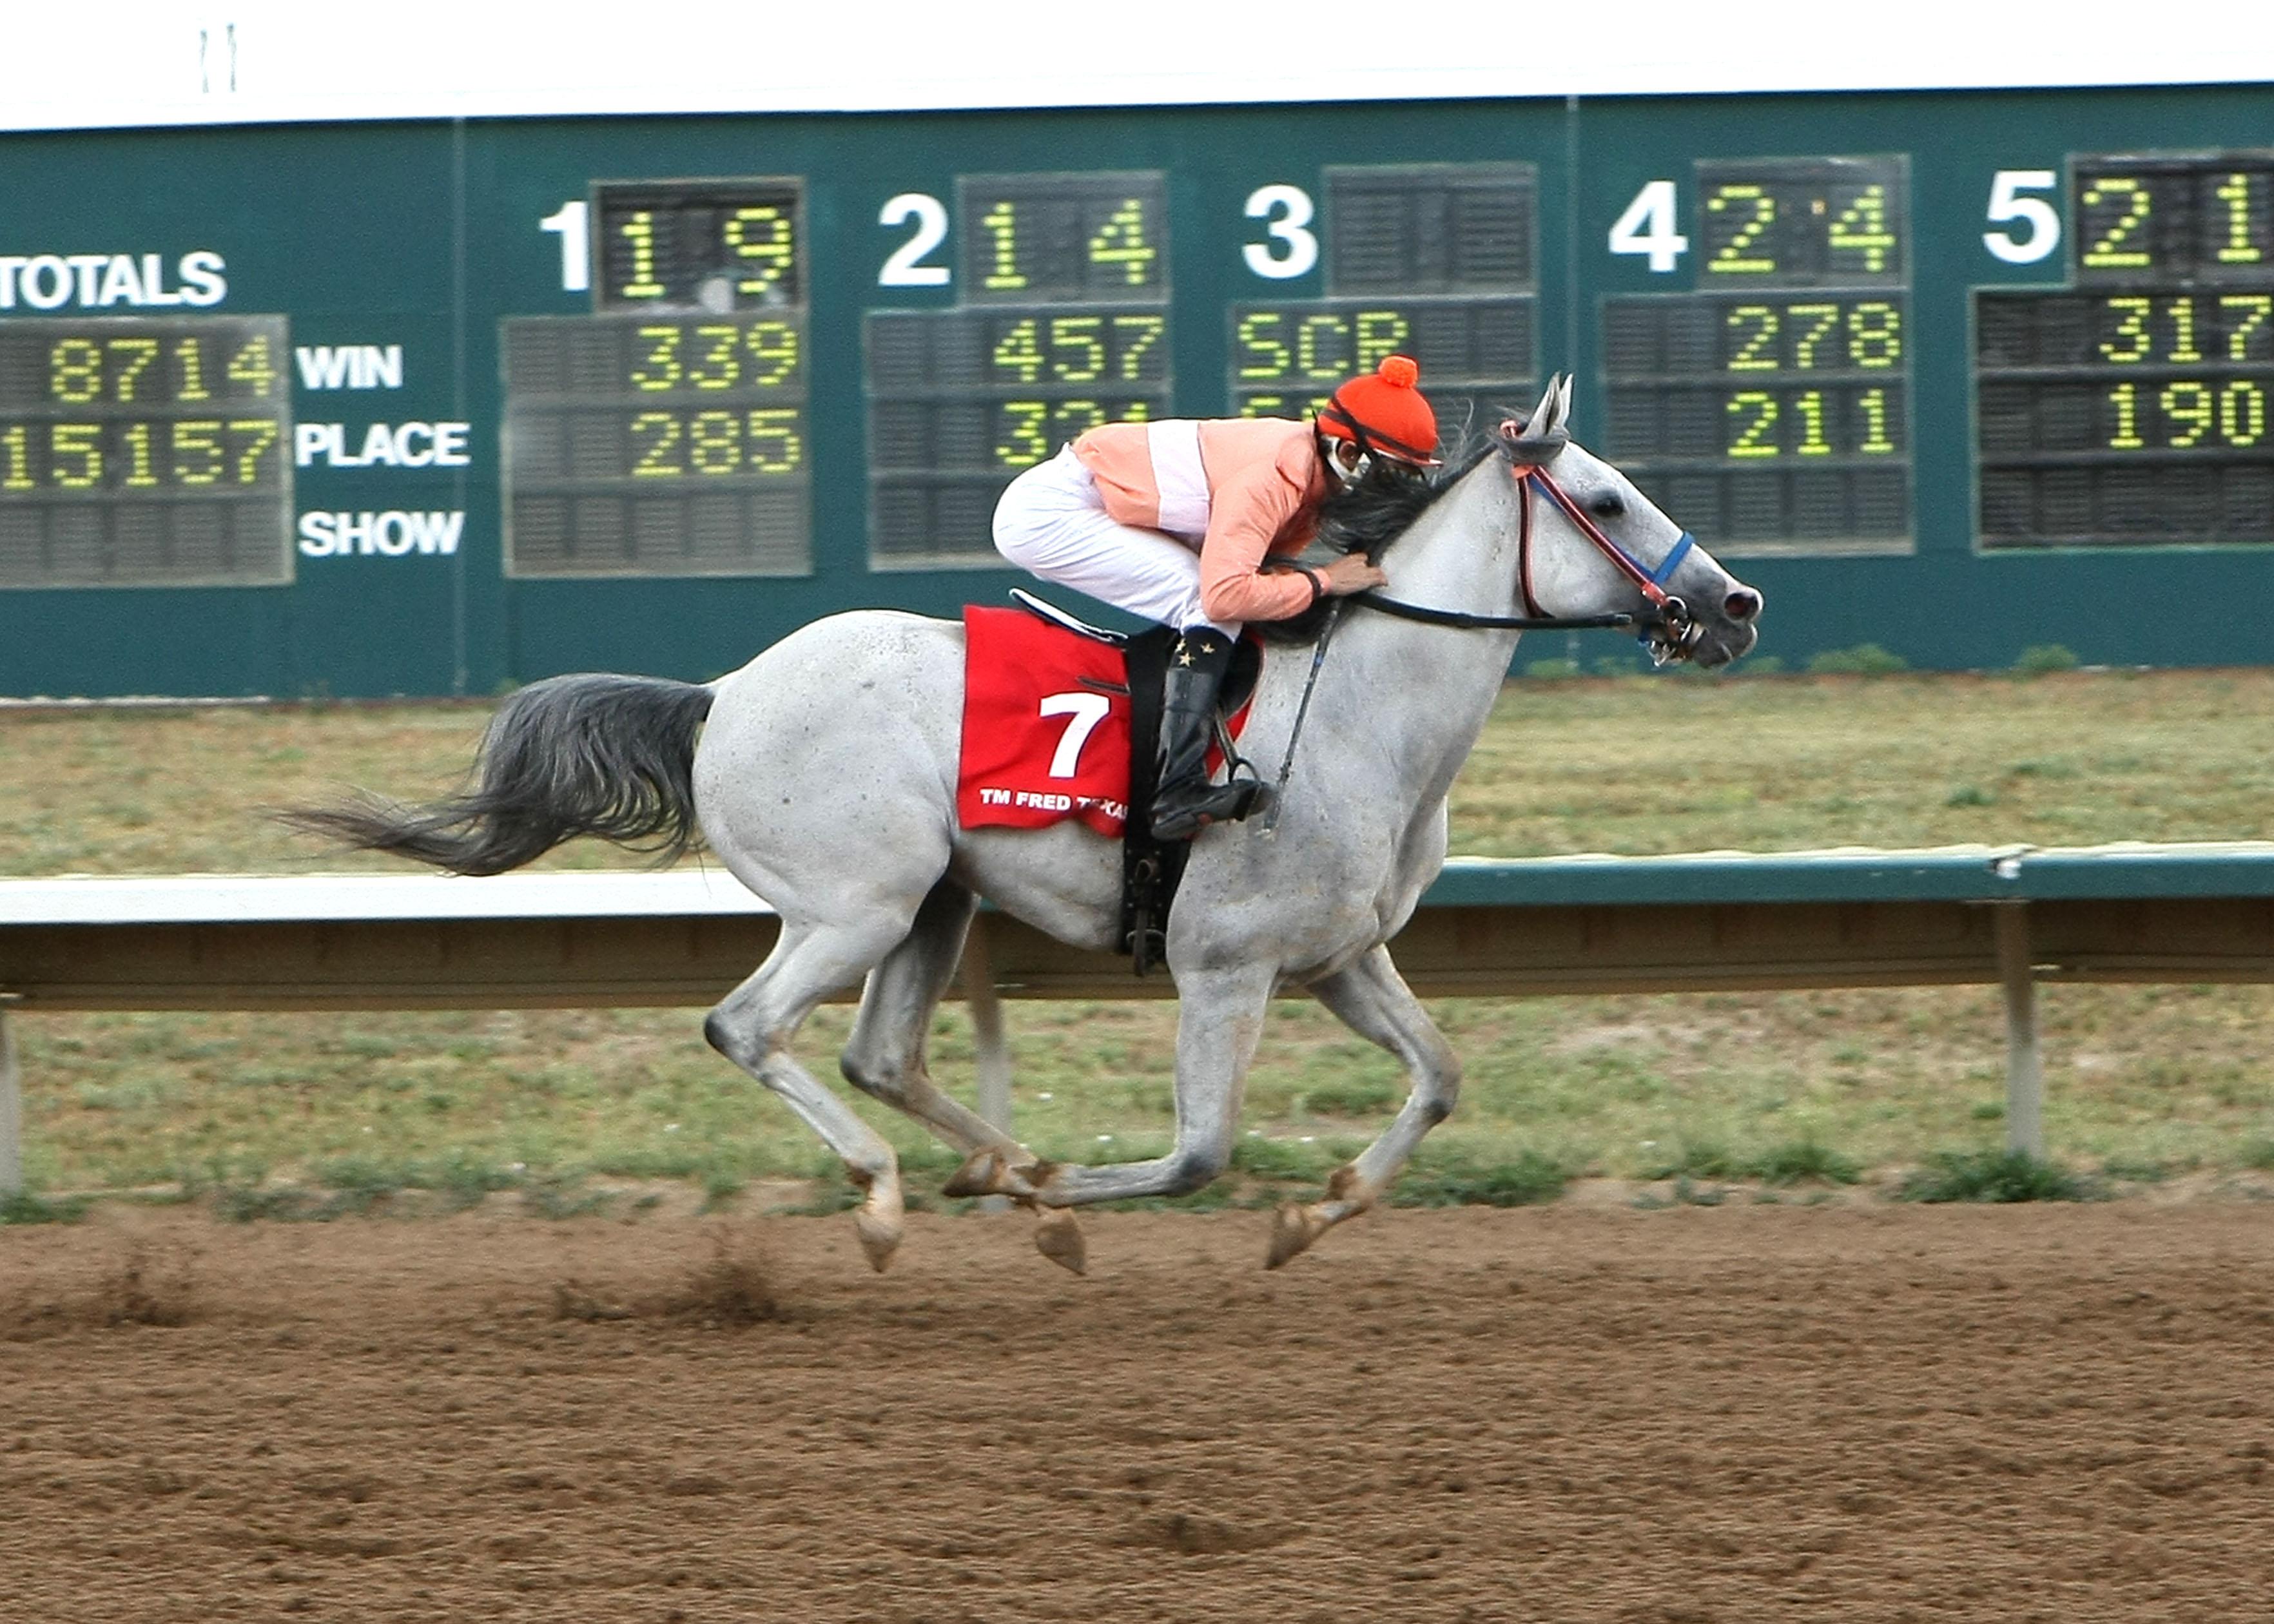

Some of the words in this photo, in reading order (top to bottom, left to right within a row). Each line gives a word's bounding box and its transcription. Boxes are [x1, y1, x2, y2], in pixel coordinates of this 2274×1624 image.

[540, 201, 588, 290] 1
[879, 193, 950, 285] 2
[1242, 185, 1317, 278] 3
[1608, 180, 1688, 272] 4
[1983, 170, 2061, 263] 5
[0, 251, 227, 308] TOTALS
[630, 320, 799, 392] 339
[993, 316, 1163, 382] 457
[1238, 311, 1409, 379] SCR
[1727, 303, 1901, 371] 278
[2099, 295, 2273, 363] 317
[51, 334, 277, 404] 8714
[295, 345, 403, 389] WIN
[295, 421, 471, 467] PLACE
[630, 408, 801, 477] 285
[1726, 389, 1894, 459] 211
[2108, 380, 2265, 450] 190
[1, 419, 279, 490] 15157
[298, 510, 465, 556] SHOW
[1039, 692, 1110, 778] 7
[979, 788, 1011, 805] TM
[1015, 791, 1072, 811] FRED
